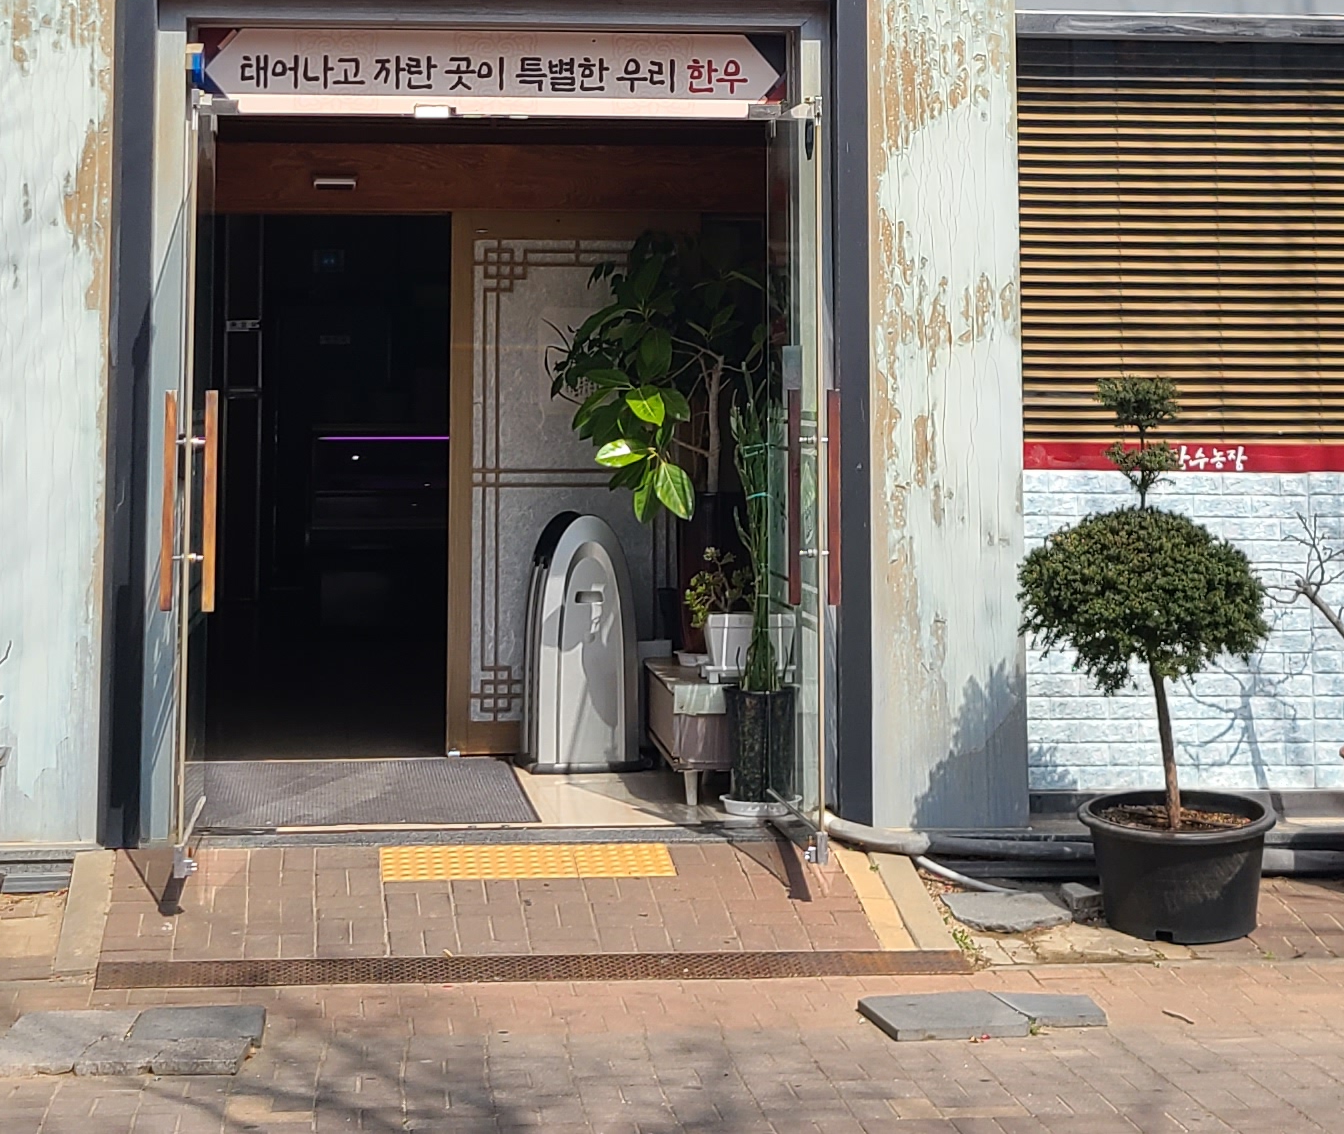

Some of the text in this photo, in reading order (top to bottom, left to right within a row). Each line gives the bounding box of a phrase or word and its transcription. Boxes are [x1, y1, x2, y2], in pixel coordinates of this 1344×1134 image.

[240, 55, 748, 94] 태어나고 자란 곳이 특별한 우리 한우
